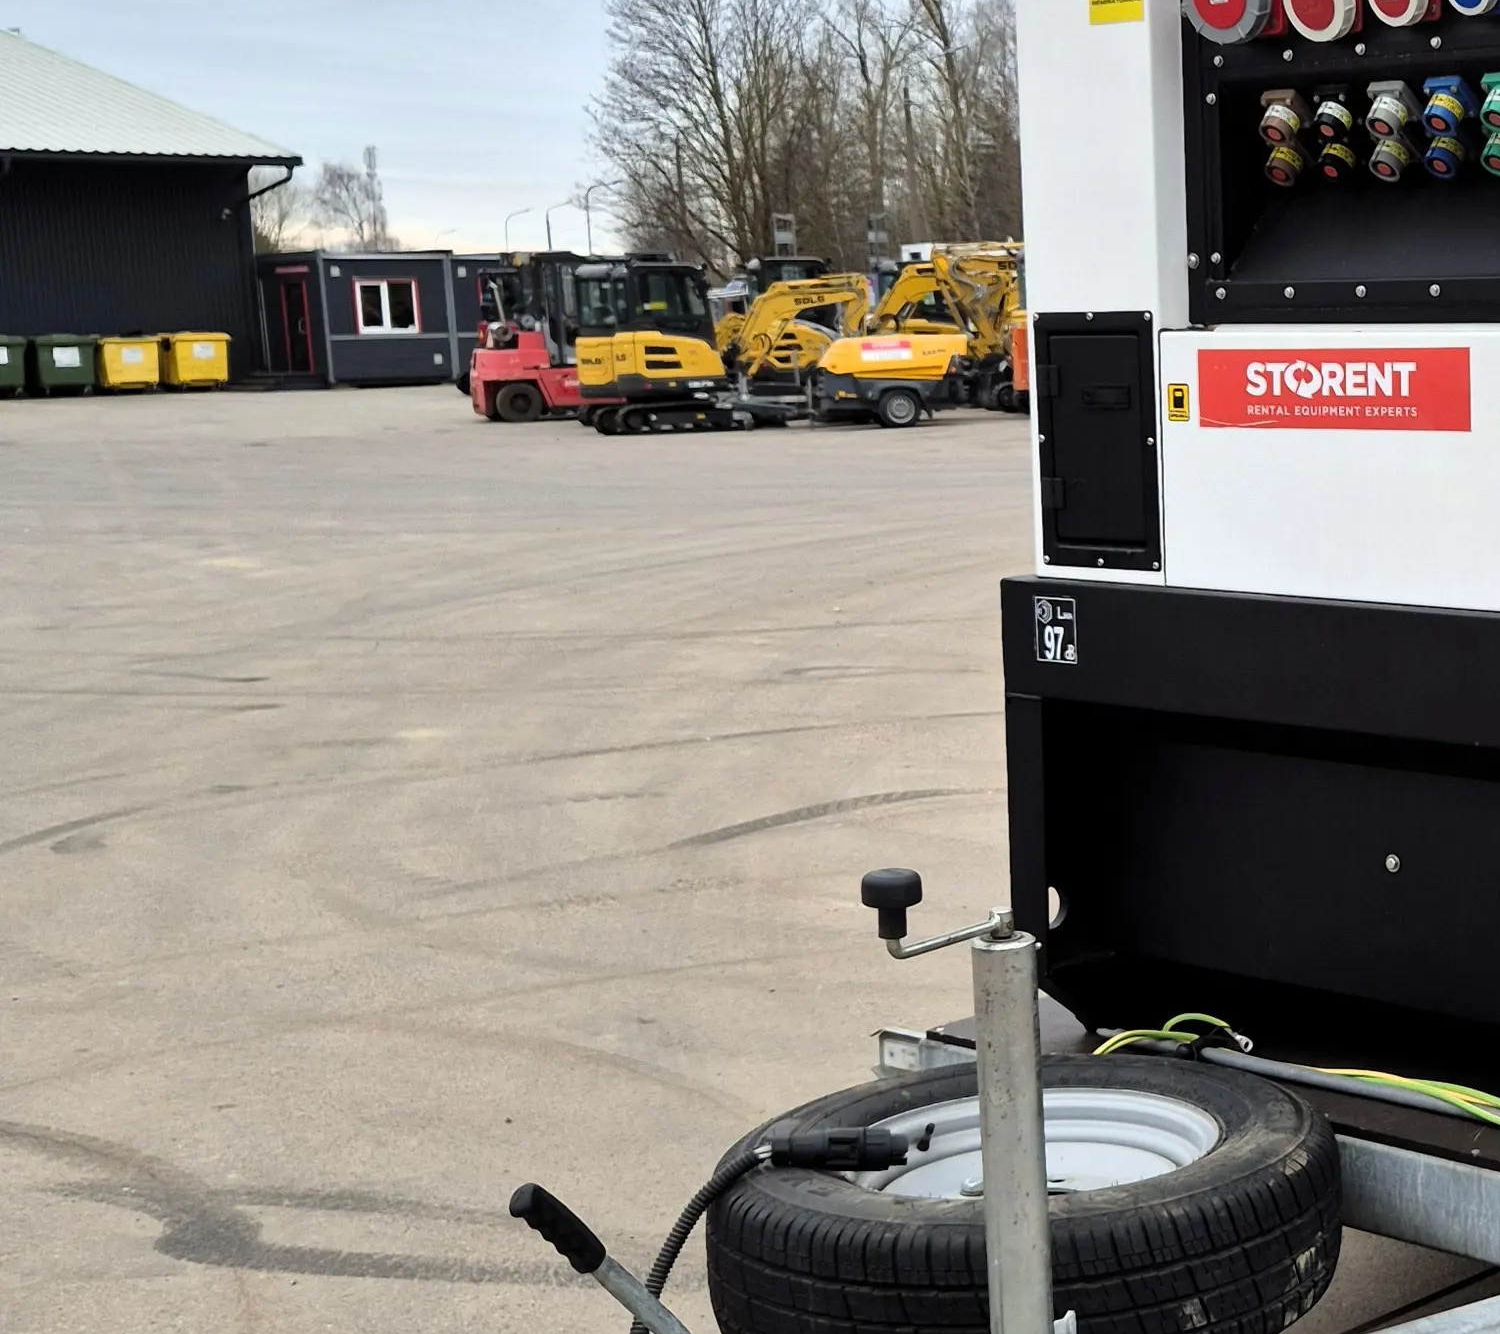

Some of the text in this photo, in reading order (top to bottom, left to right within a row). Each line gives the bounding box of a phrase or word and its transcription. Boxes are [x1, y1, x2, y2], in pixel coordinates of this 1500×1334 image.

[1245, 359, 1417, 399] STORENT
[1247, 404, 1418, 418] RENTAL EQUIPMENT EXPERTS
[1043, 624, 1064, 660] 97
